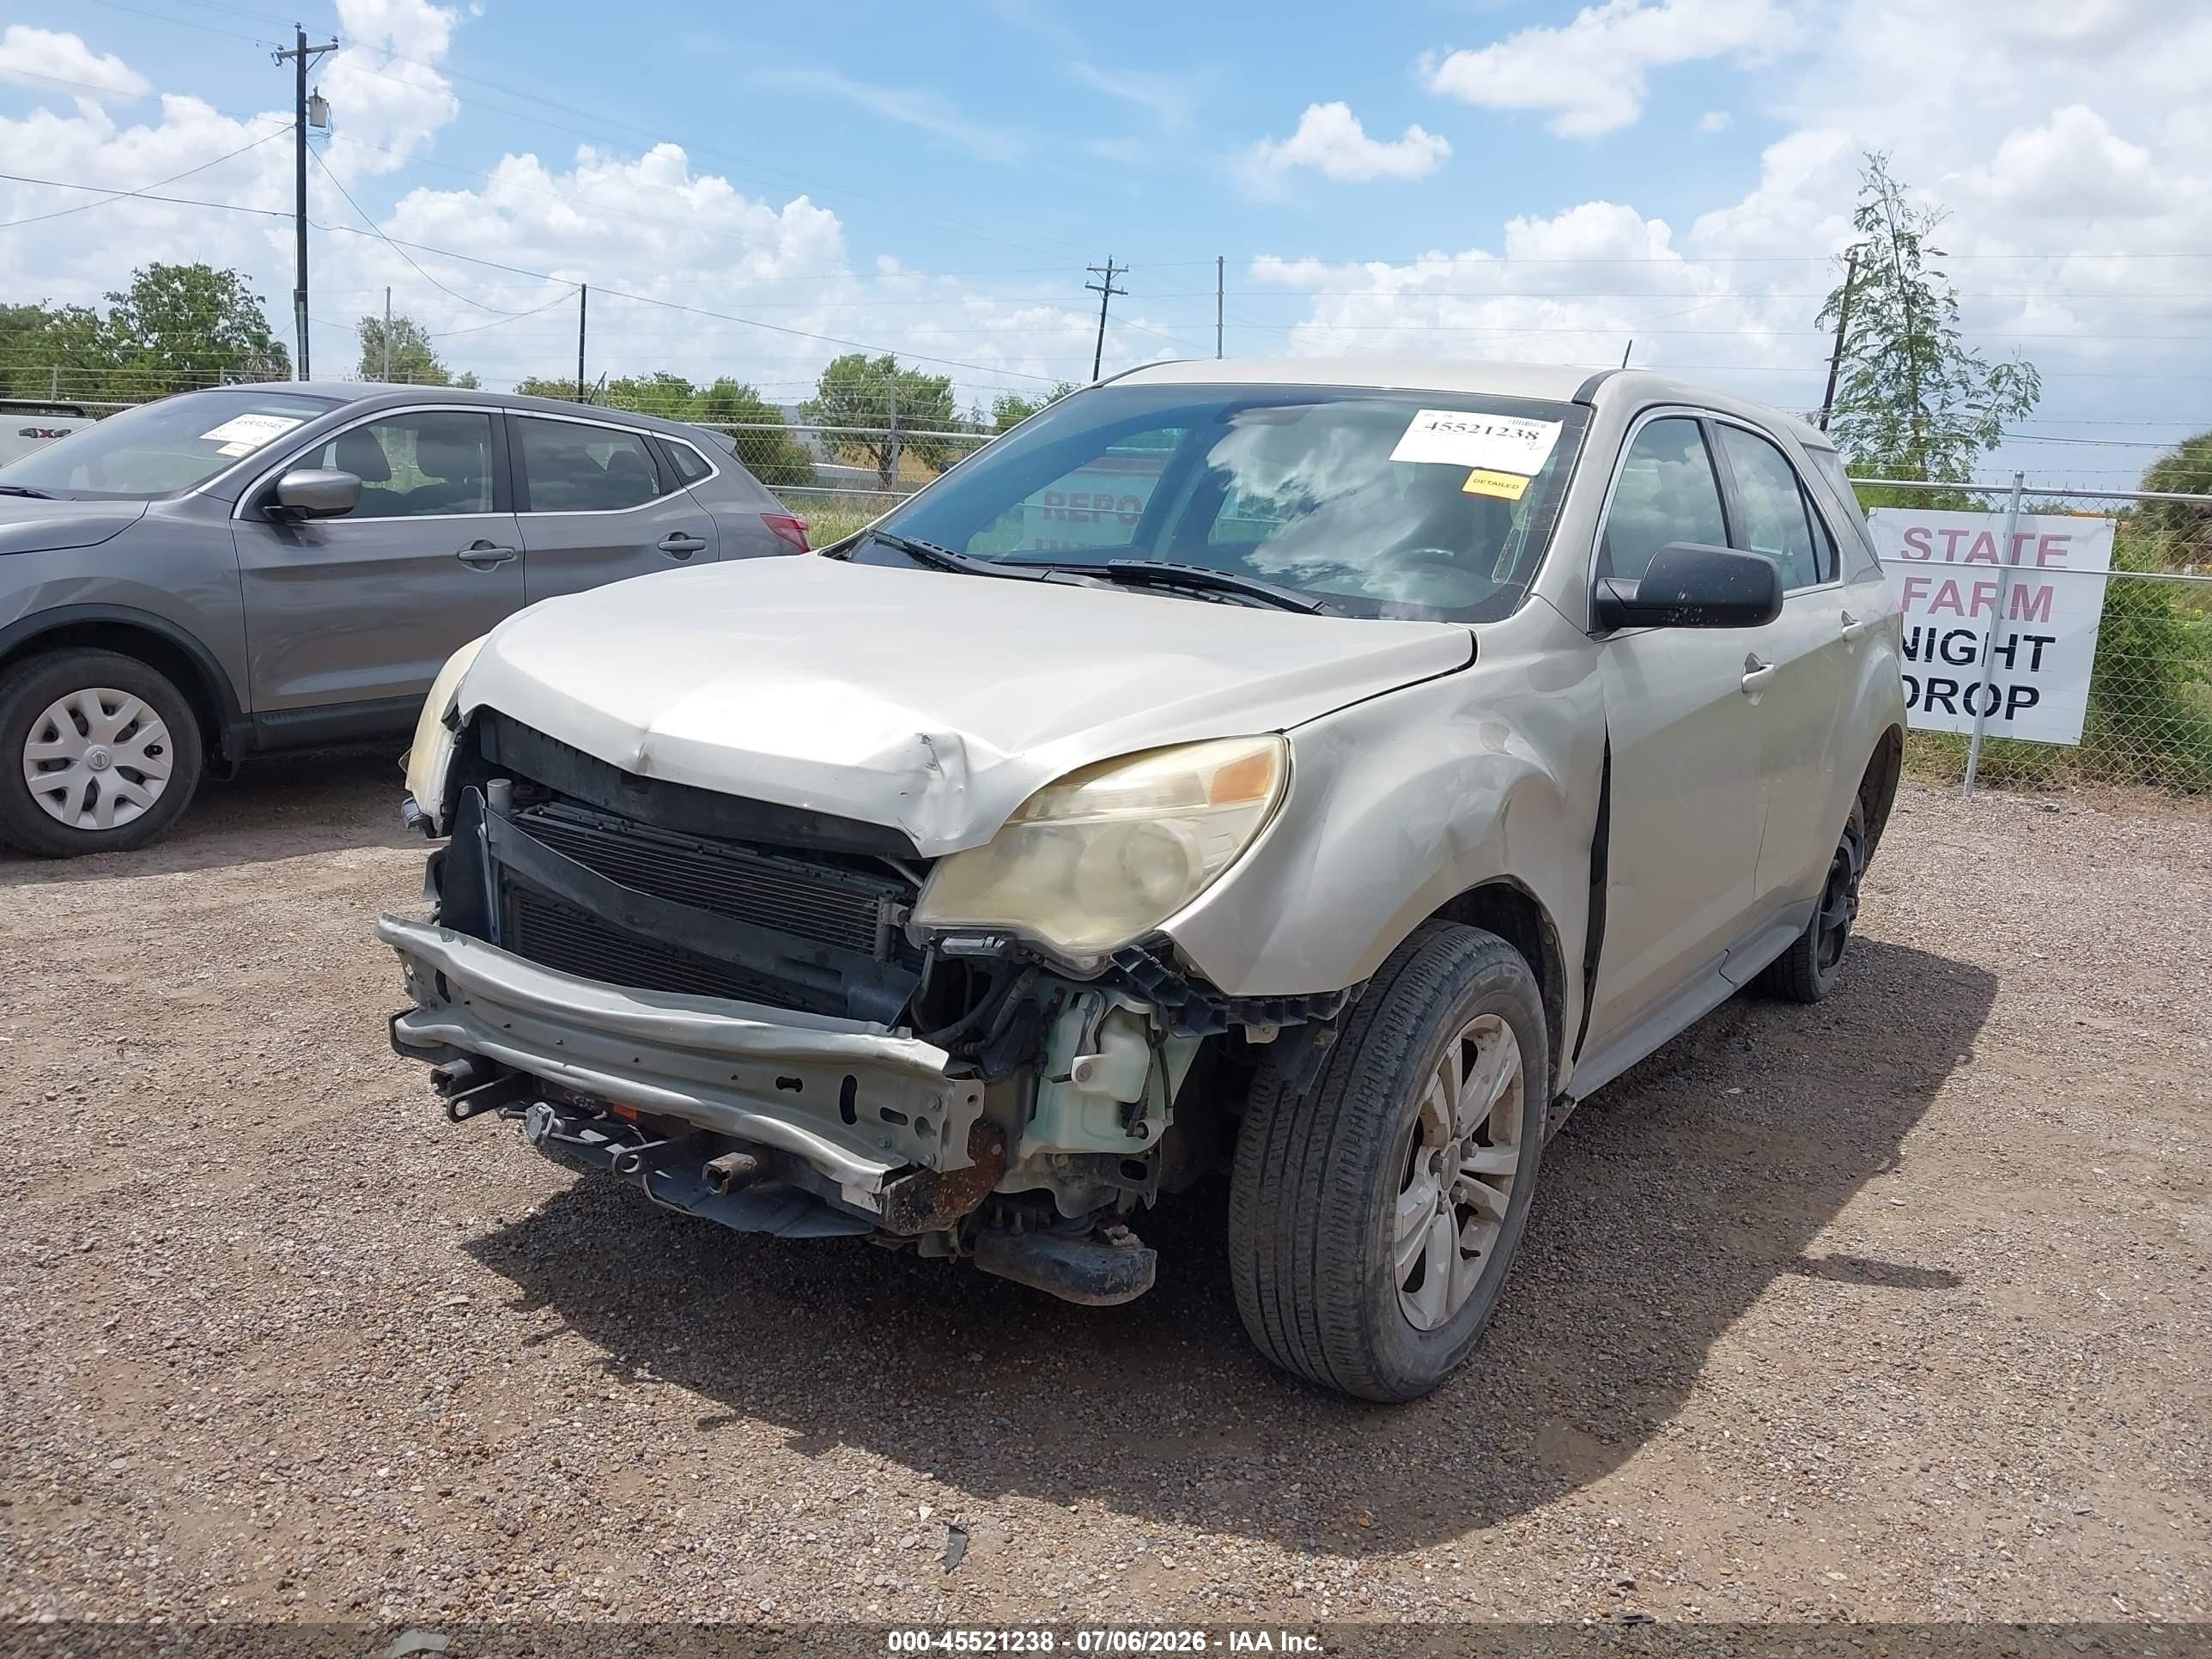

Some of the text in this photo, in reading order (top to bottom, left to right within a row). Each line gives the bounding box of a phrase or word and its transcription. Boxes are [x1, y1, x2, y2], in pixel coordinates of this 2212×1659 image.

[1425, 421, 1540, 441] 45521238
[1473, 477, 1519, 490] DETAILED
[1043, 490, 1144, 526] REPO
[1900, 526, 2072, 570] STATE
[1900, 576, 2054, 623] FARM
